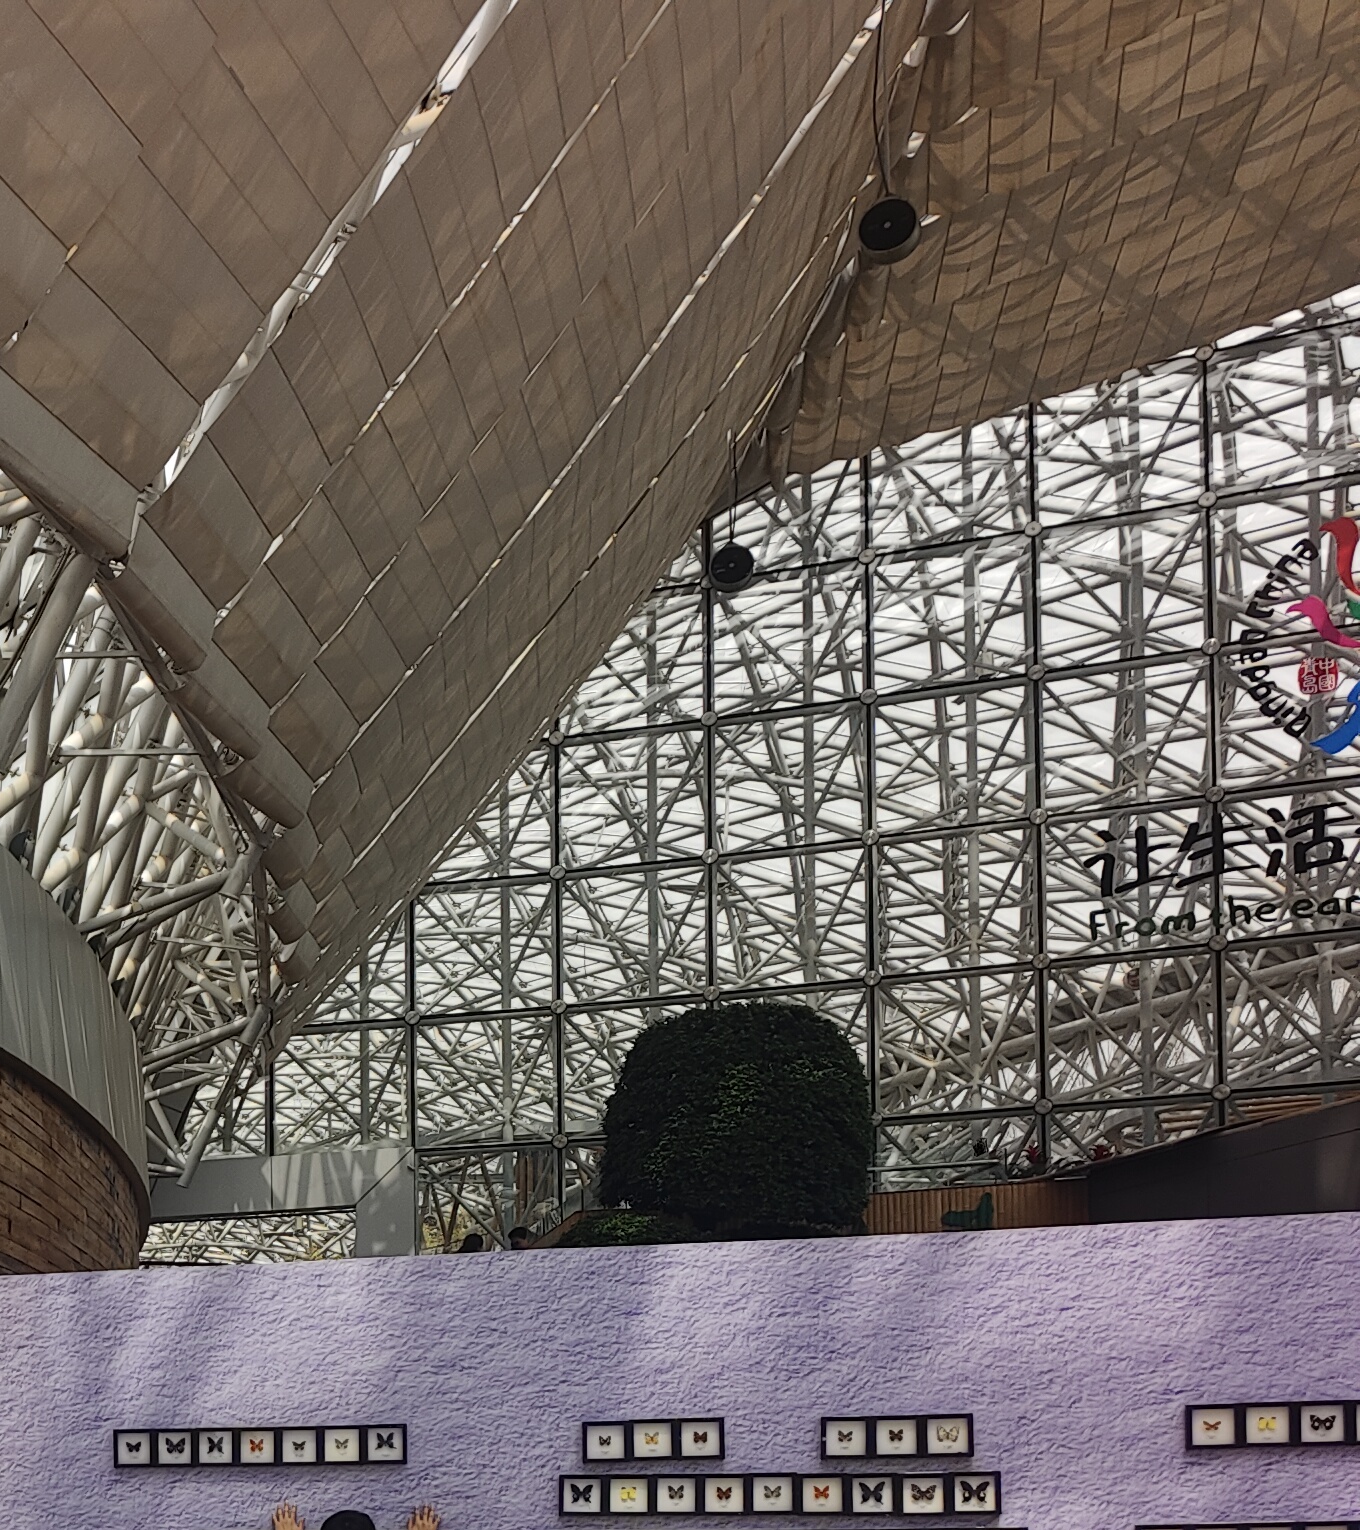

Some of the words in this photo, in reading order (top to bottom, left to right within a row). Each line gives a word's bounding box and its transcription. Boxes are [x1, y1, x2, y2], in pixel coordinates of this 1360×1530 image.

[1083, 802, 1360, 897] 让生活
[1089, 907, 1196, 940] From
[1209, 894, 1278, 929] the
